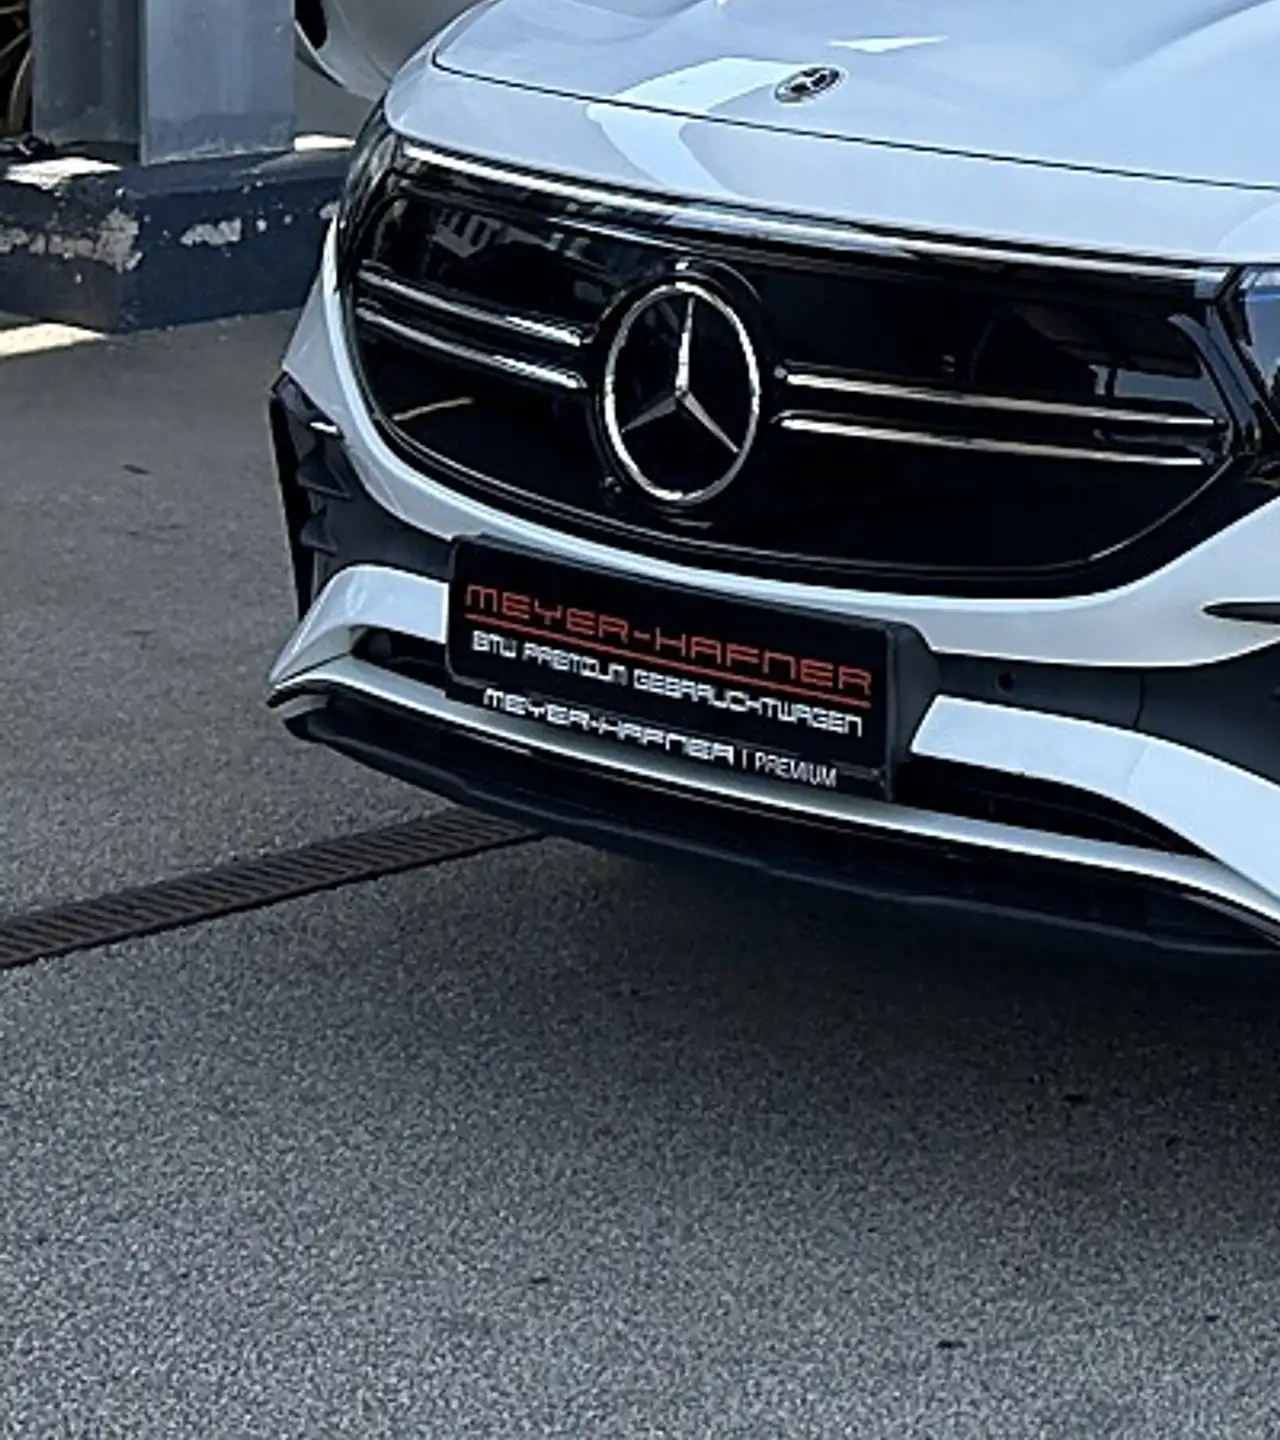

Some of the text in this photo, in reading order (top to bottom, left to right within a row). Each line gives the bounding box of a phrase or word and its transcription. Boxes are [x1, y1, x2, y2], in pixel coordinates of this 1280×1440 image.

[465, 584, 873, 696] MEYER-HAFNER
[483, 687, 735, 767] MEYER-HAFNER
[755, 751, 838, 788] PREMIUM
[633, 668, 863, 738] GEBRAUCHTWAGEN
